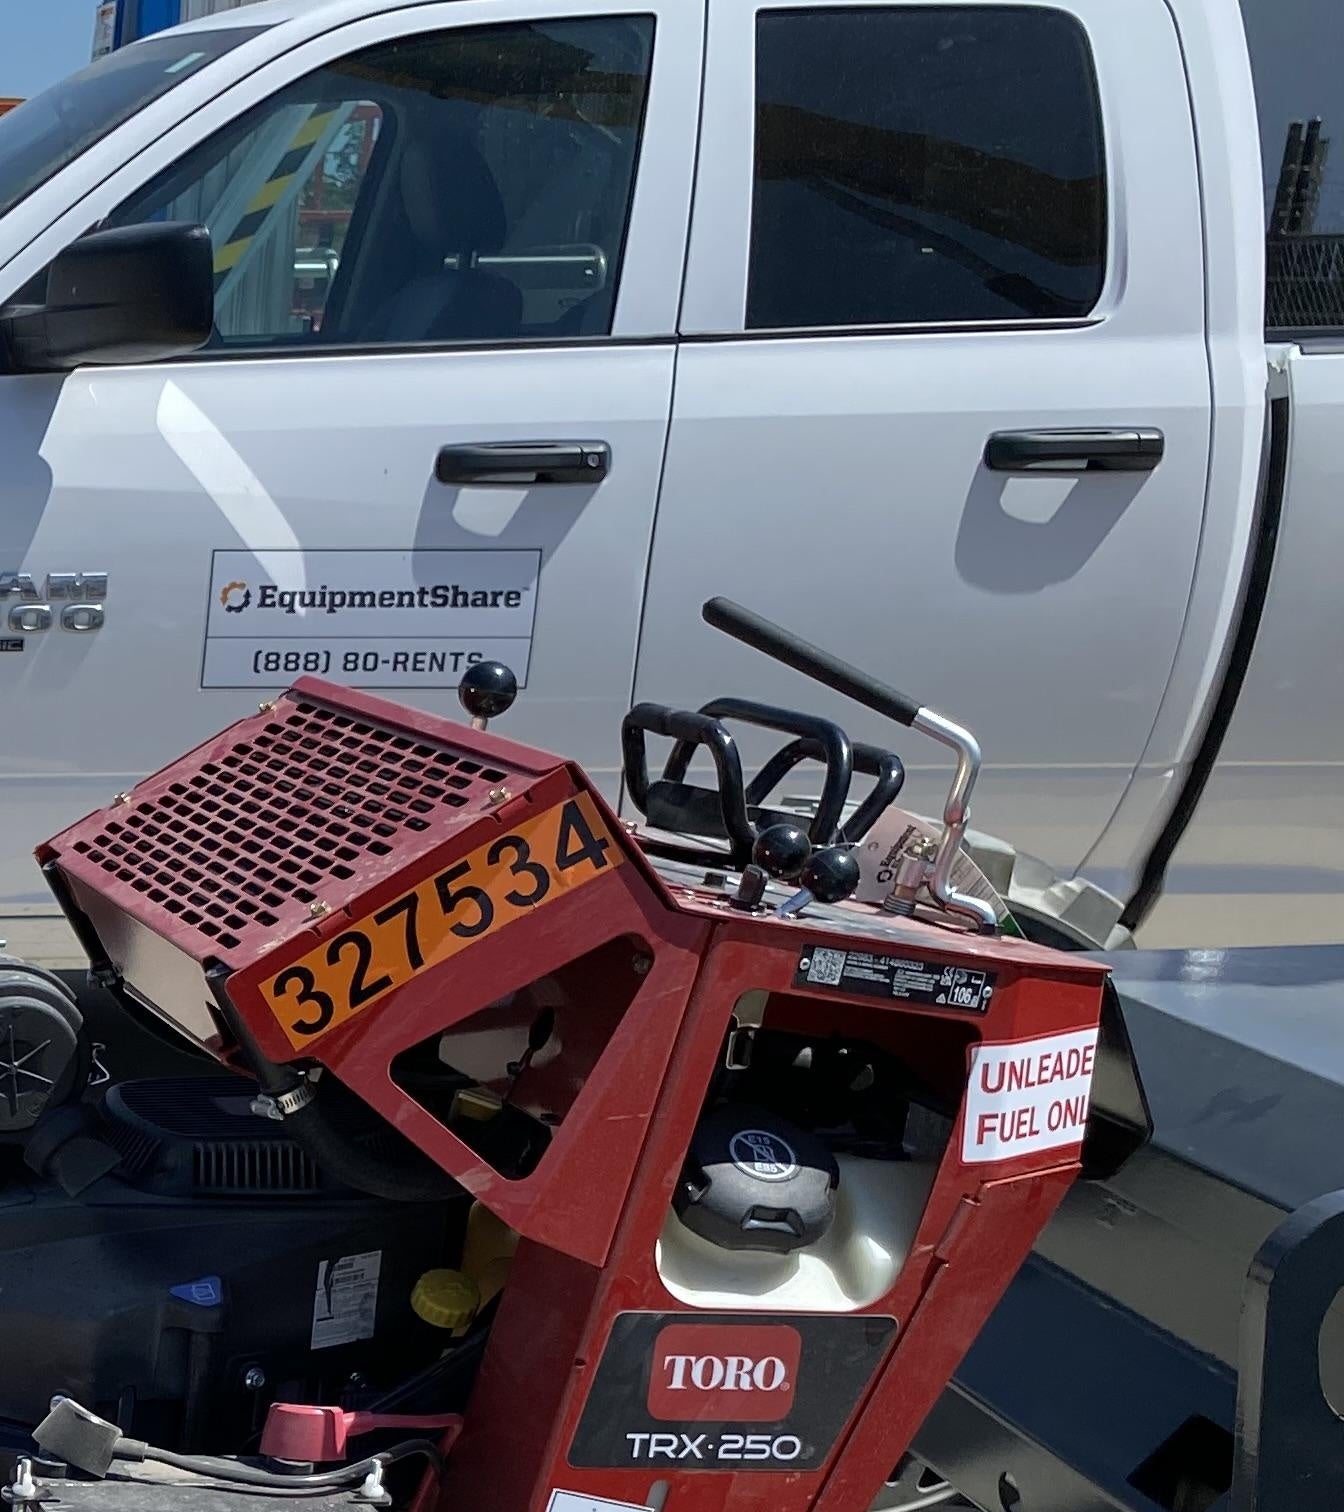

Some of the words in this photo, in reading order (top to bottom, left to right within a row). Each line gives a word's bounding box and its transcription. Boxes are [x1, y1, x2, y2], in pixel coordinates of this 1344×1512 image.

[257, 585, 522, 614] EquipmentShare
[253, 650, 331, 674] (888)
[272, 800, 609, 1036] 327534
[953, 986, 972, 1004] 106
[980, 1045, 1094, 1094] UNLEADE
[976, 1106, 1040, 1145] FUEL
[664, 1355, 786, 1391] TORO
